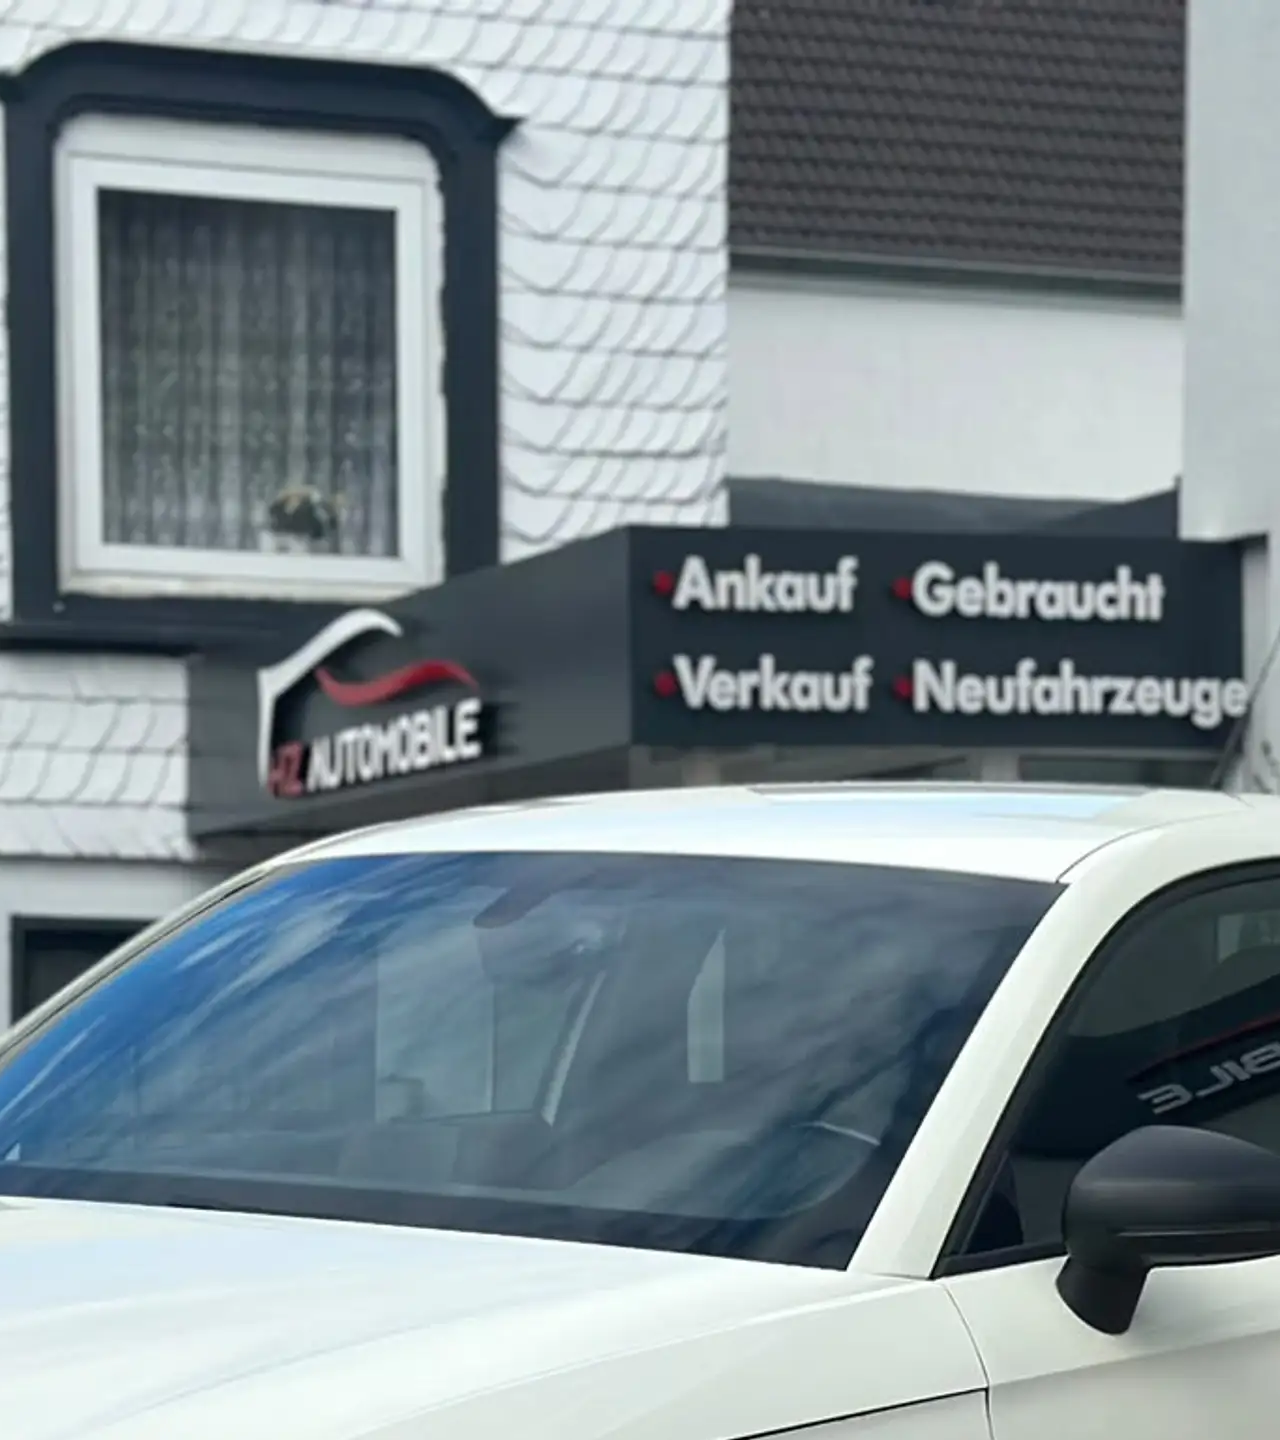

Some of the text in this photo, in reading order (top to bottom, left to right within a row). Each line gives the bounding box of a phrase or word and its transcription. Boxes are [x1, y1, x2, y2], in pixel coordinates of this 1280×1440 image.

[672, 553, 859, 612] Ankauf
[912, 560, 1165, 621] Gebraucht
[672, 653, 874, 711] Verkauf
[912, 657, 1250, 729] Neufahrzeuge
[268, 698, 482, 796] HZ AUTOMOBILE
